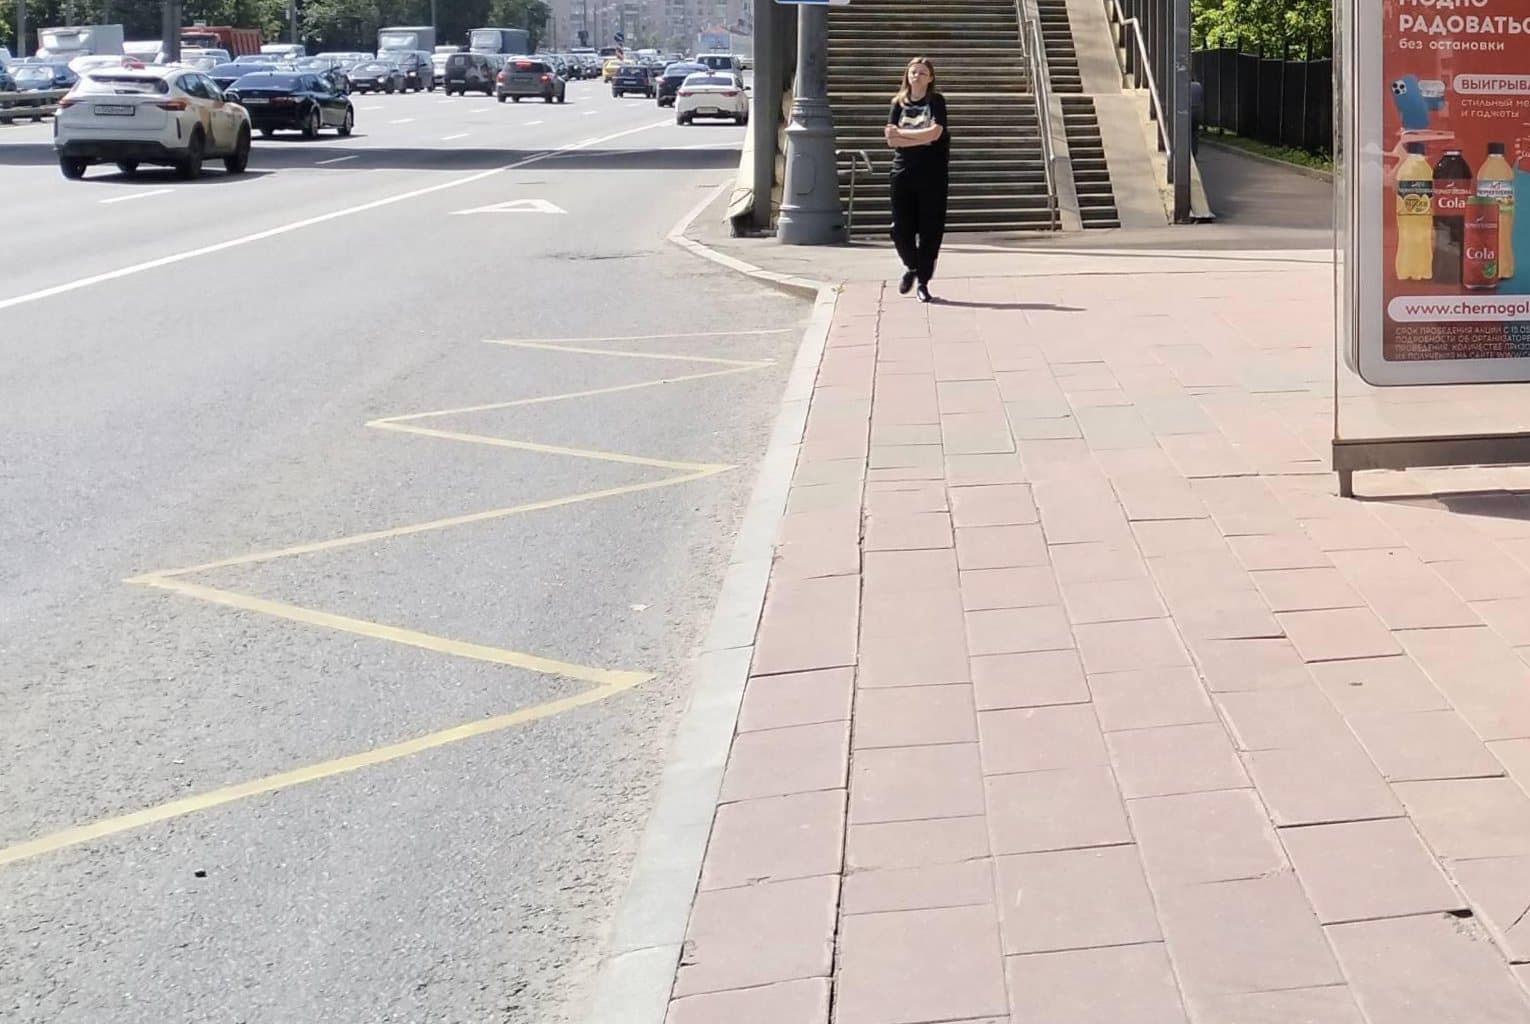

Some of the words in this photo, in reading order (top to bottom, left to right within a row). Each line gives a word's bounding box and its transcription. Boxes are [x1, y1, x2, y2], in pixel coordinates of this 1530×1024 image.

[1399, 38, 1423, 50] без
[1429, 41, 1505, 51] остановки
[1438, 197, 1466, 209] Cola
[1466, 247, 1495, 260] Cola
